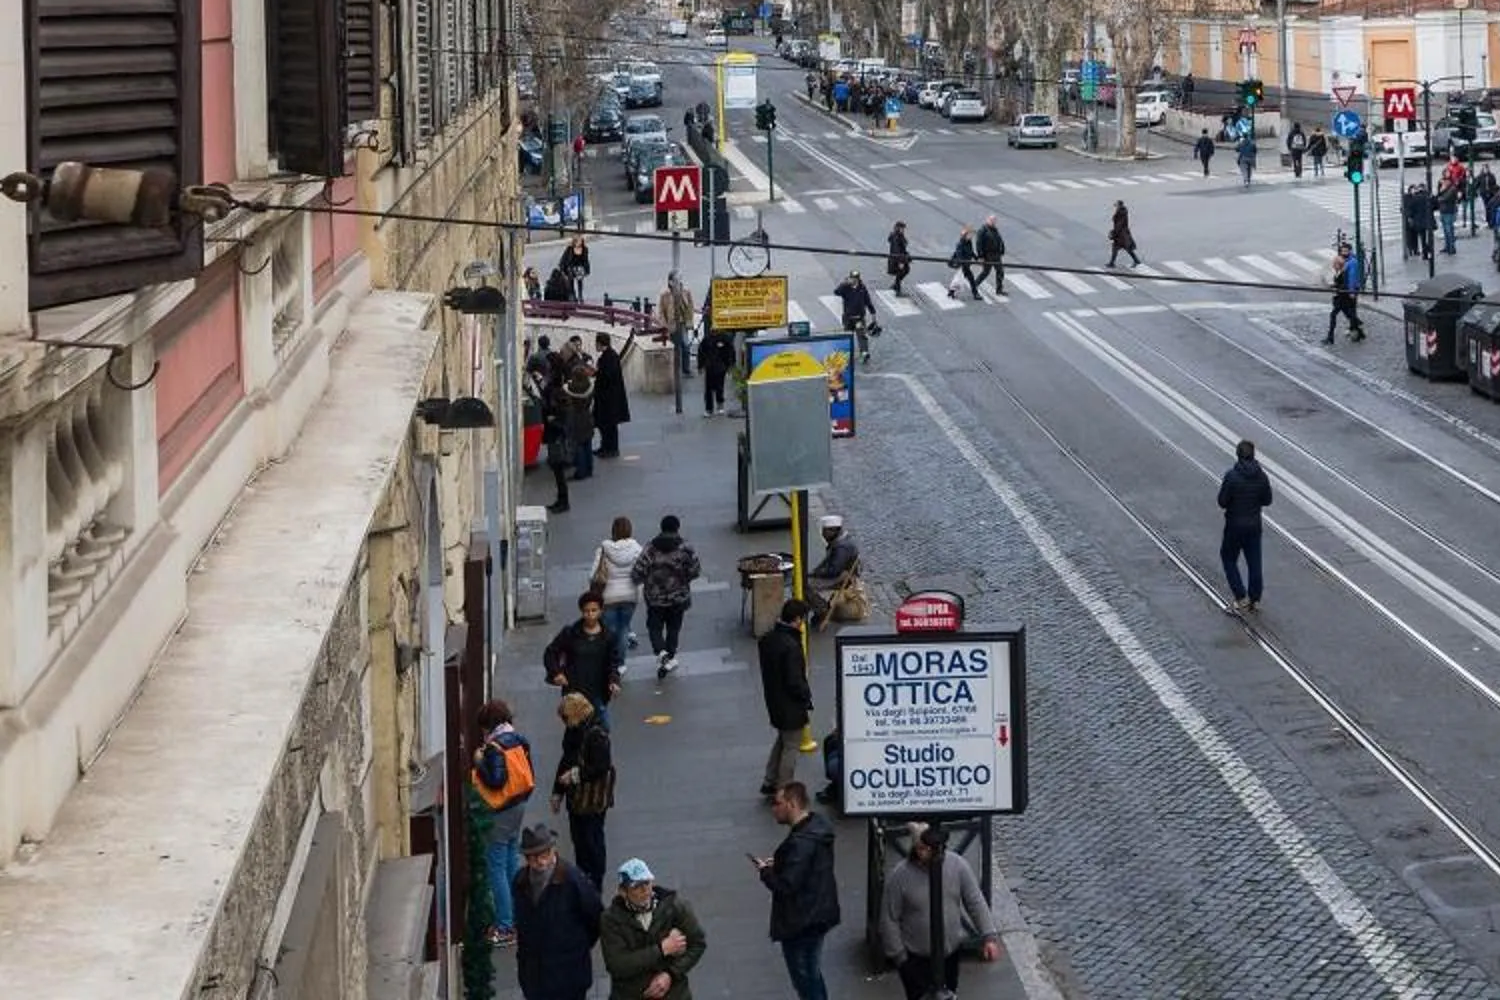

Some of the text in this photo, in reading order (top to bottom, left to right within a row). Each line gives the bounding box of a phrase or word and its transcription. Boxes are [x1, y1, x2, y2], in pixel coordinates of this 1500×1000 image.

[1387, 93, 1414, 113] M
[659, 175, 697, 203] M
[876, 649, 988, 677] MORAS
[863, 679, 975, 707] OTTICA
[884, 743, 955, 765] Studio
[849, 764, 991, 790] OCULISTICO
